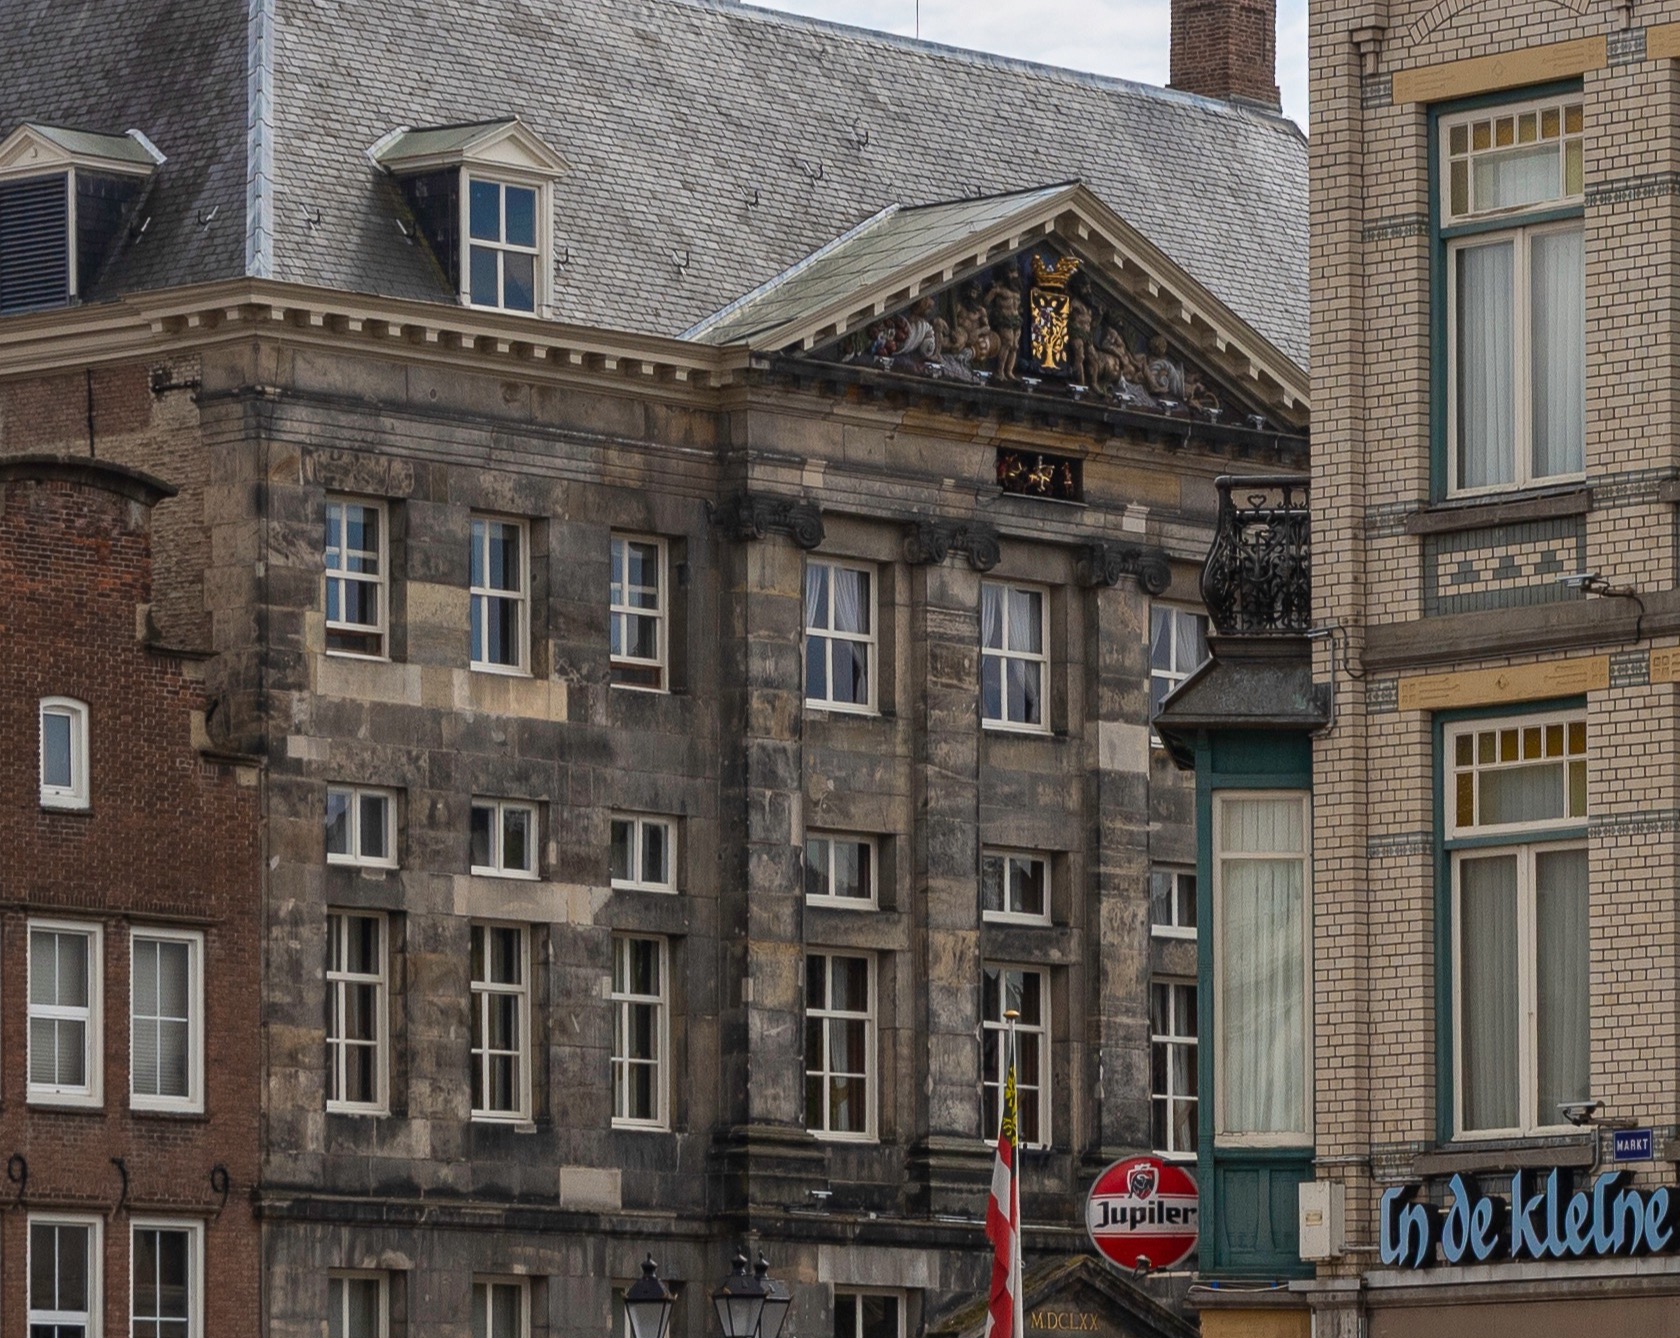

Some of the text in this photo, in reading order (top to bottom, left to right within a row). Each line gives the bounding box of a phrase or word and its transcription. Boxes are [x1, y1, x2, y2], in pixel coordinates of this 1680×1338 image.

[1617, 1138, 1650, 1152] MARKT
[1094, 1201, 1198, 1231] Jupiler
[1380, 1186, 1430, 1269] In
[1441, 1173, 1500, 1264] de
[1511, 1167, 1673, 1259] kleine
